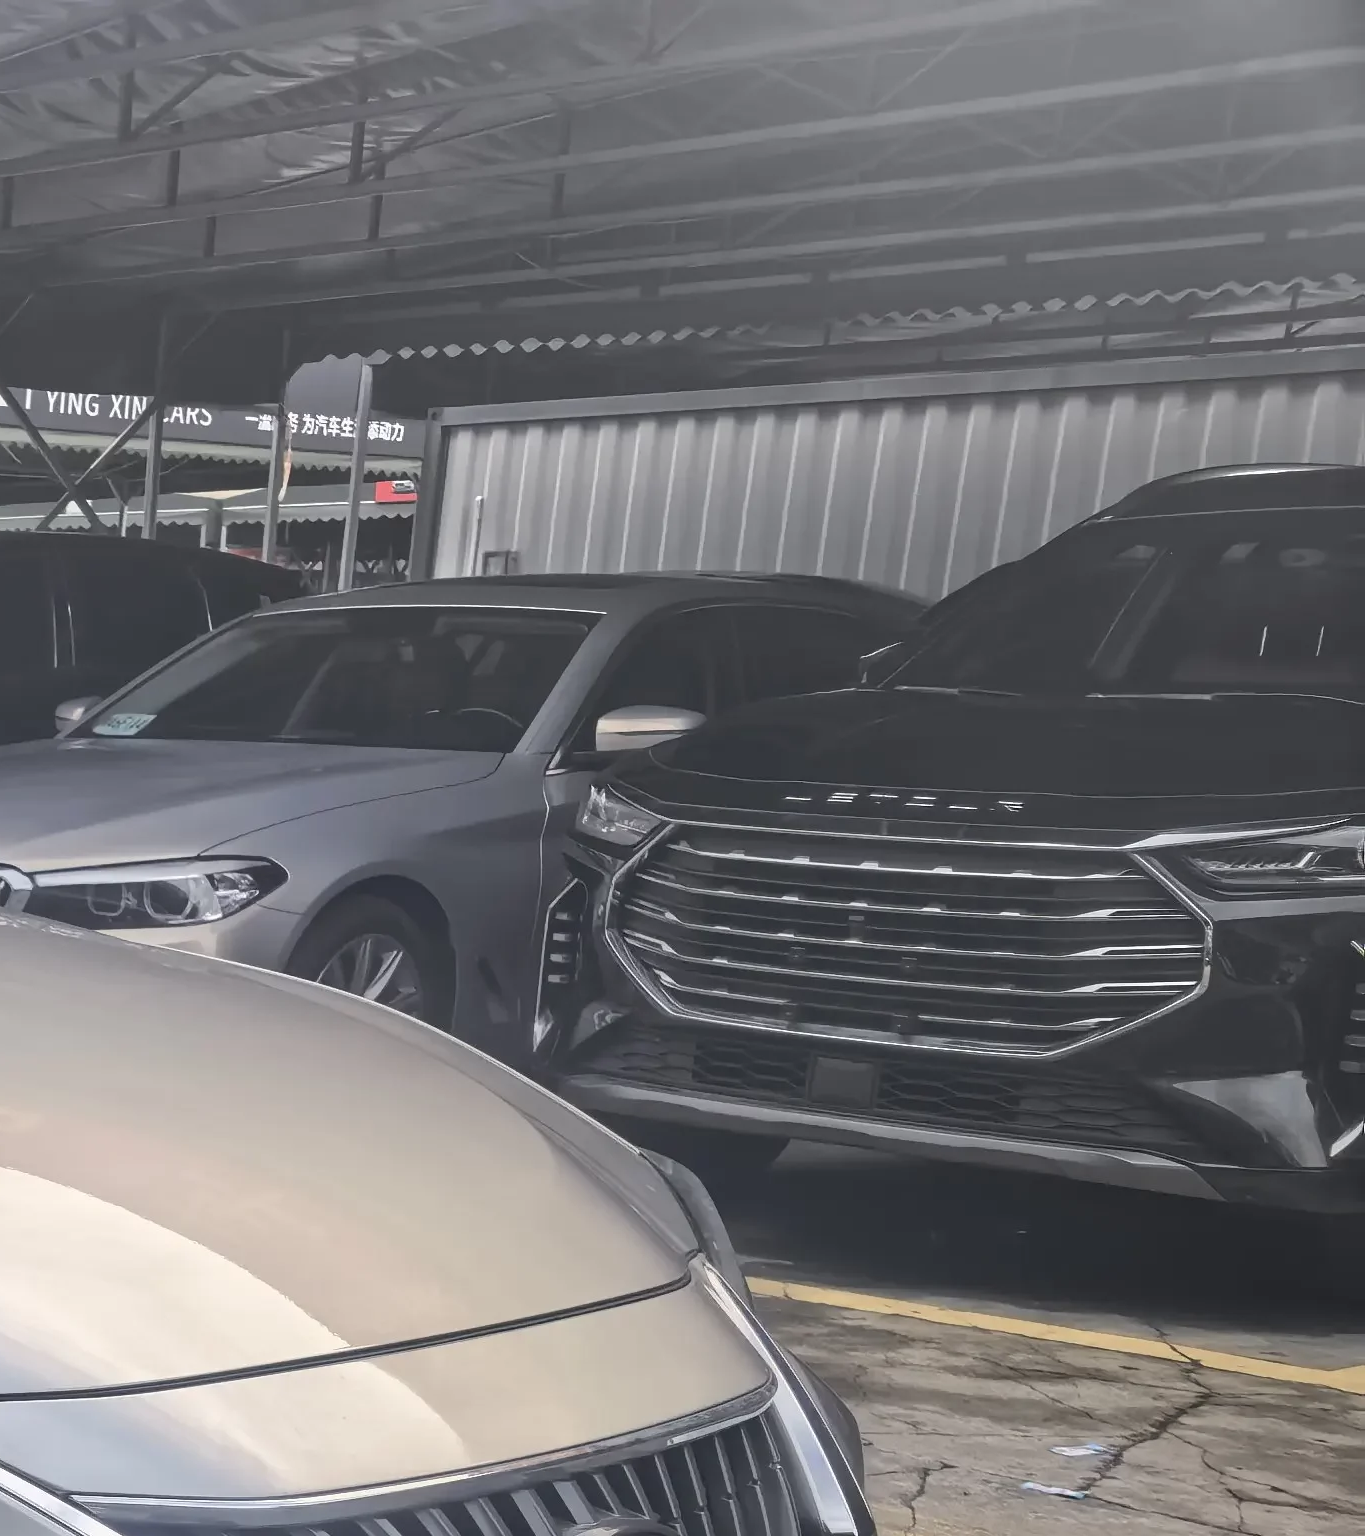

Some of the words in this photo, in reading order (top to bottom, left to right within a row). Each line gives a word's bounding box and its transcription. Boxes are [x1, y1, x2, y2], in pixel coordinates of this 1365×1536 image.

[46, 390, 100, 417] YING
[108, 394, 148, 421] XIN
[162, 406, 213, 427] ARS
[301, 413, 405, 442] 为汽车生添动力
